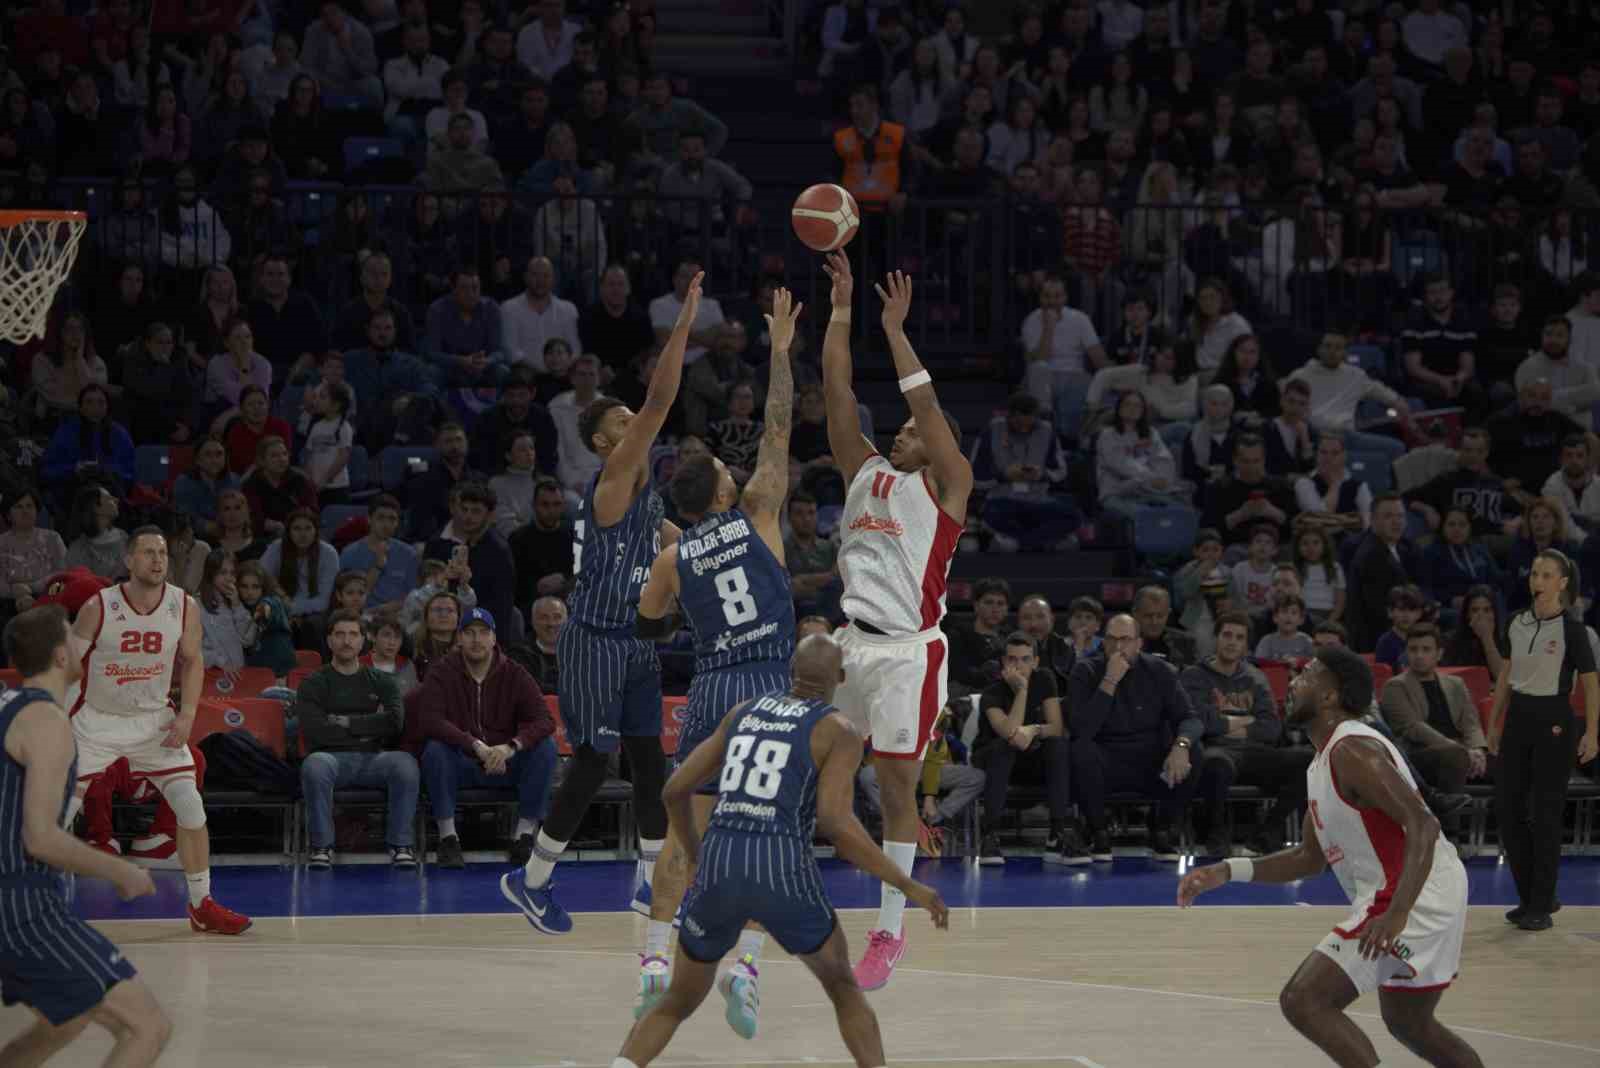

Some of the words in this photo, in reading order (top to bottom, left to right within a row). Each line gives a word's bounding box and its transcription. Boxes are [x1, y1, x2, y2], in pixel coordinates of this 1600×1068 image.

[871, 471, 897, 500] 11
[680, 519, 750, 560] WEILER-BABB
[692, 542, 749, 576] Bilyoner
[714, 566, 758, 626] 8
[120, 630, 162, 654] 28
[752, 696, 811, 717] JONES
[720, 735, 792, 799] 88
